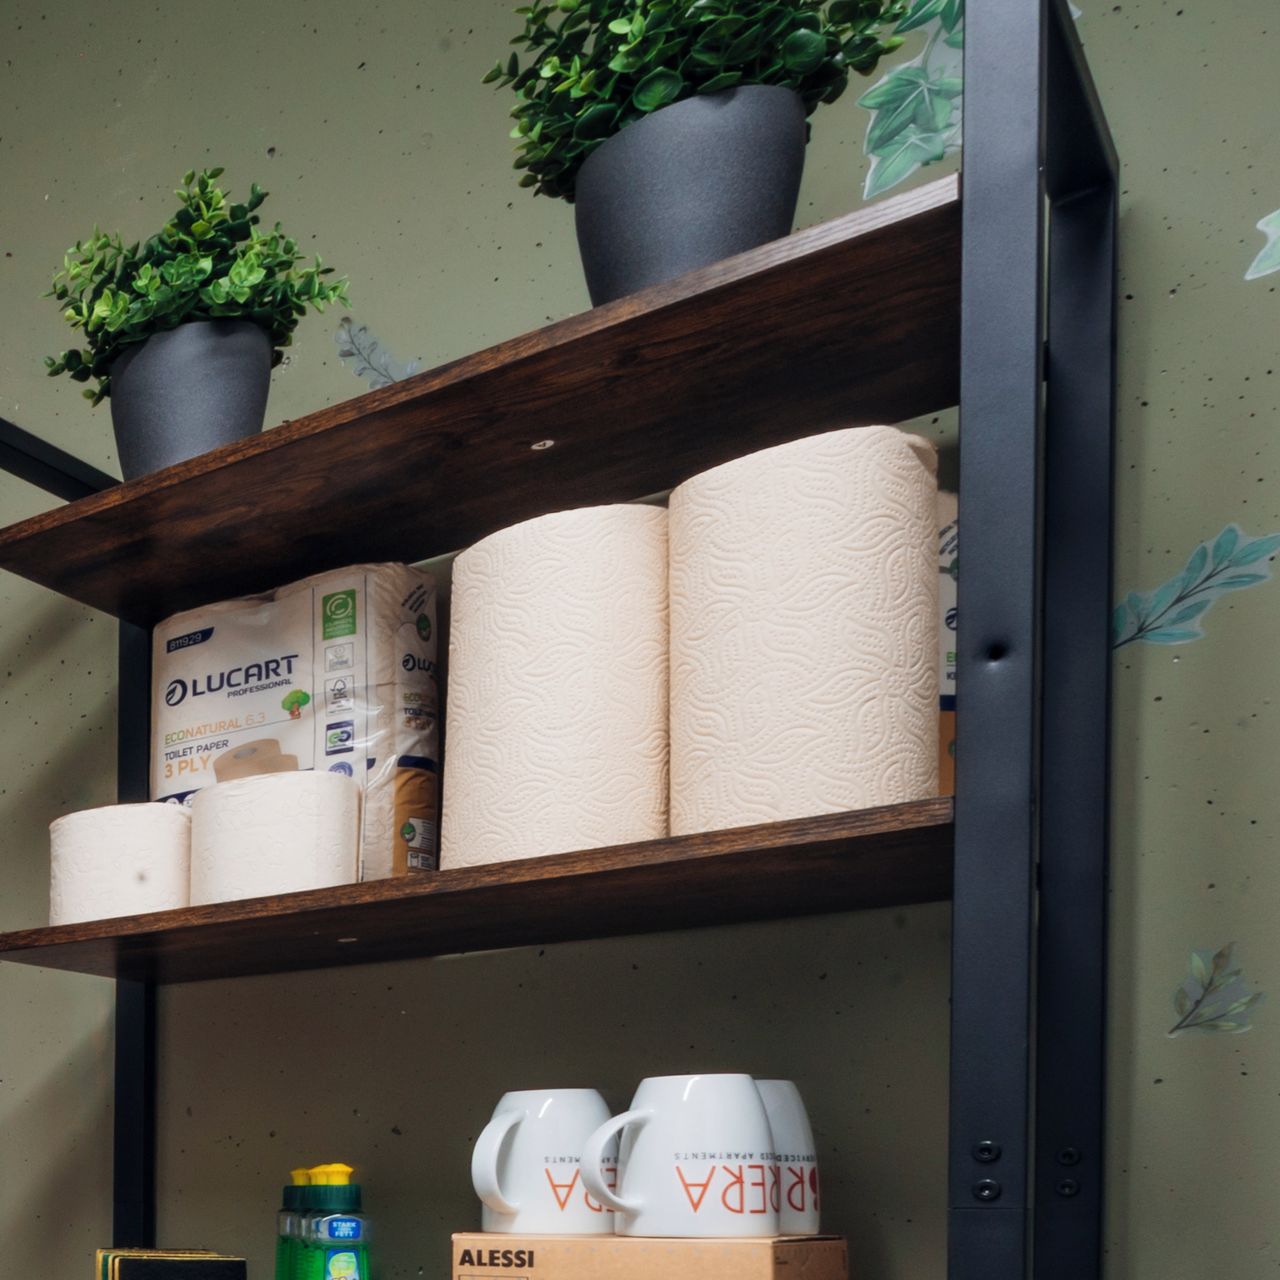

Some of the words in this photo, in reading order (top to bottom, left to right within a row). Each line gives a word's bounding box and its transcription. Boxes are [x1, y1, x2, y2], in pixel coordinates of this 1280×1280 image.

[169, 632, 202, 651] 811929
[192, 654, 299, 697] LUCART
[227, 679, 293, 699] PROFESSIONAL
[164, 717, 242, 745] ECONATURAL
[244, 712, 268, 727] 6.3
[164, 746, 194, 762] TOILET
[196, 739, 229, 755] PAPER
[164, 763, 173, 779] 3
[178, 754, 212, 776] PLY
[673, 1152, 753, 1161] APARTMENTS
[459, 1249, 535, 1268] ALESSI
